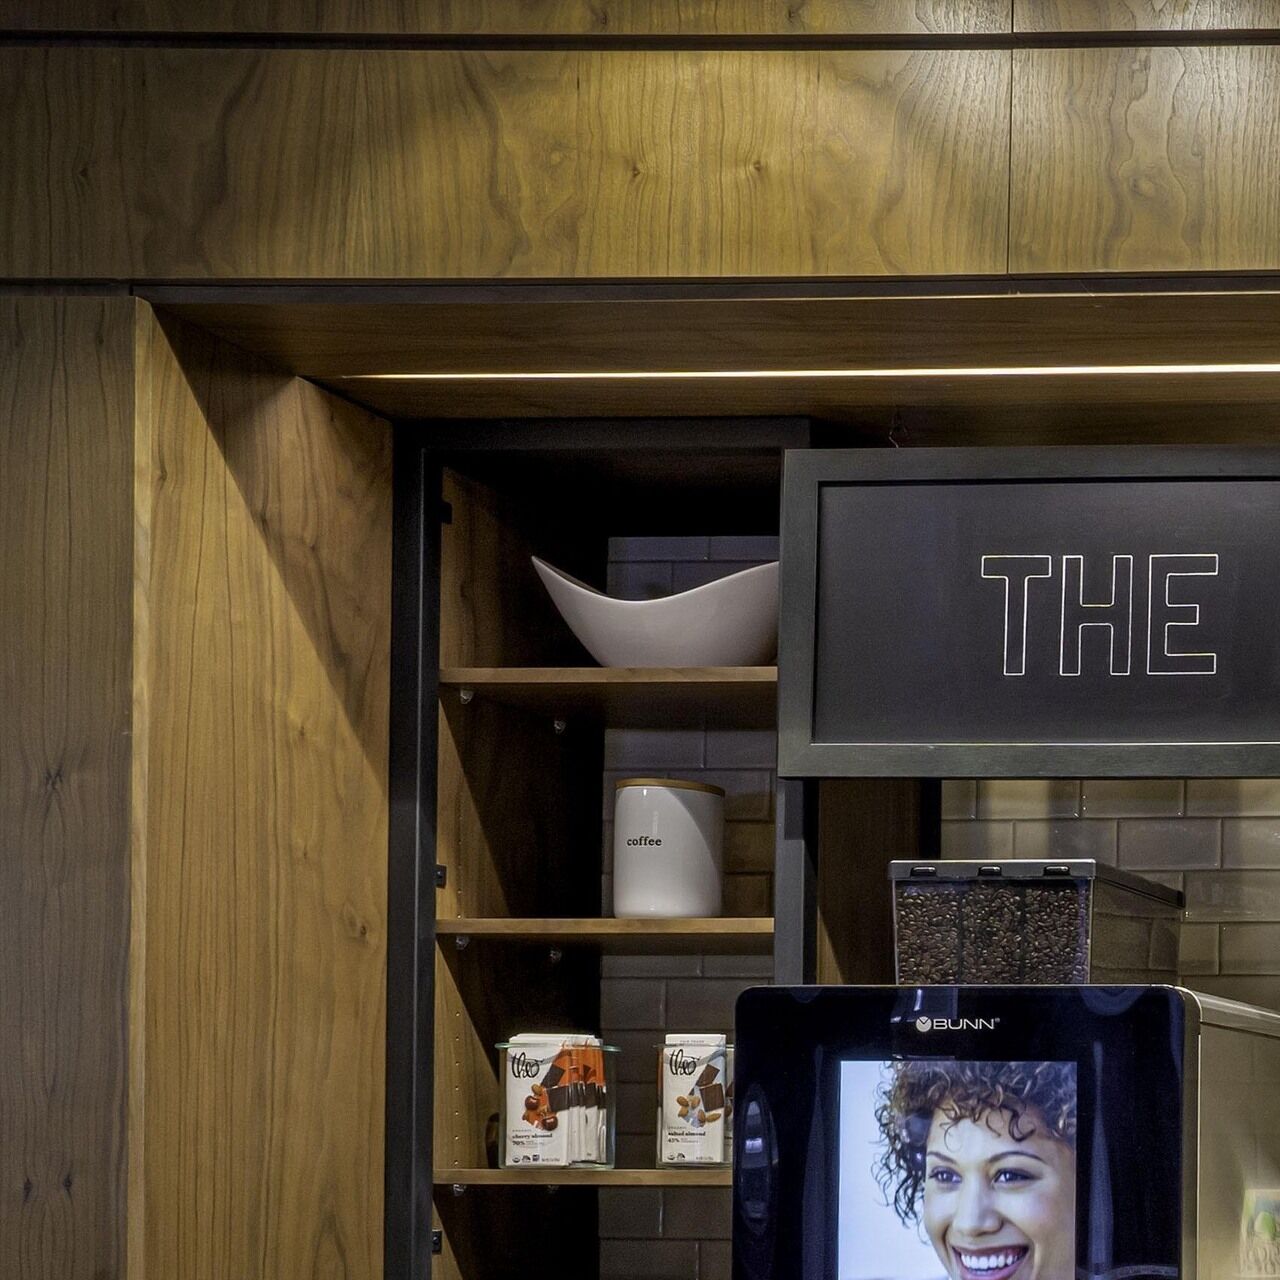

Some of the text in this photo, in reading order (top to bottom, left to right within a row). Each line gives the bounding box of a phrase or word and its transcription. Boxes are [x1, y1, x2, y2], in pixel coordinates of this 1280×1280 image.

[981, 553, 1219, 676] THE
[626, 835, 662, 847] coffee
[932, 1018, 995, 1030] BUNN
